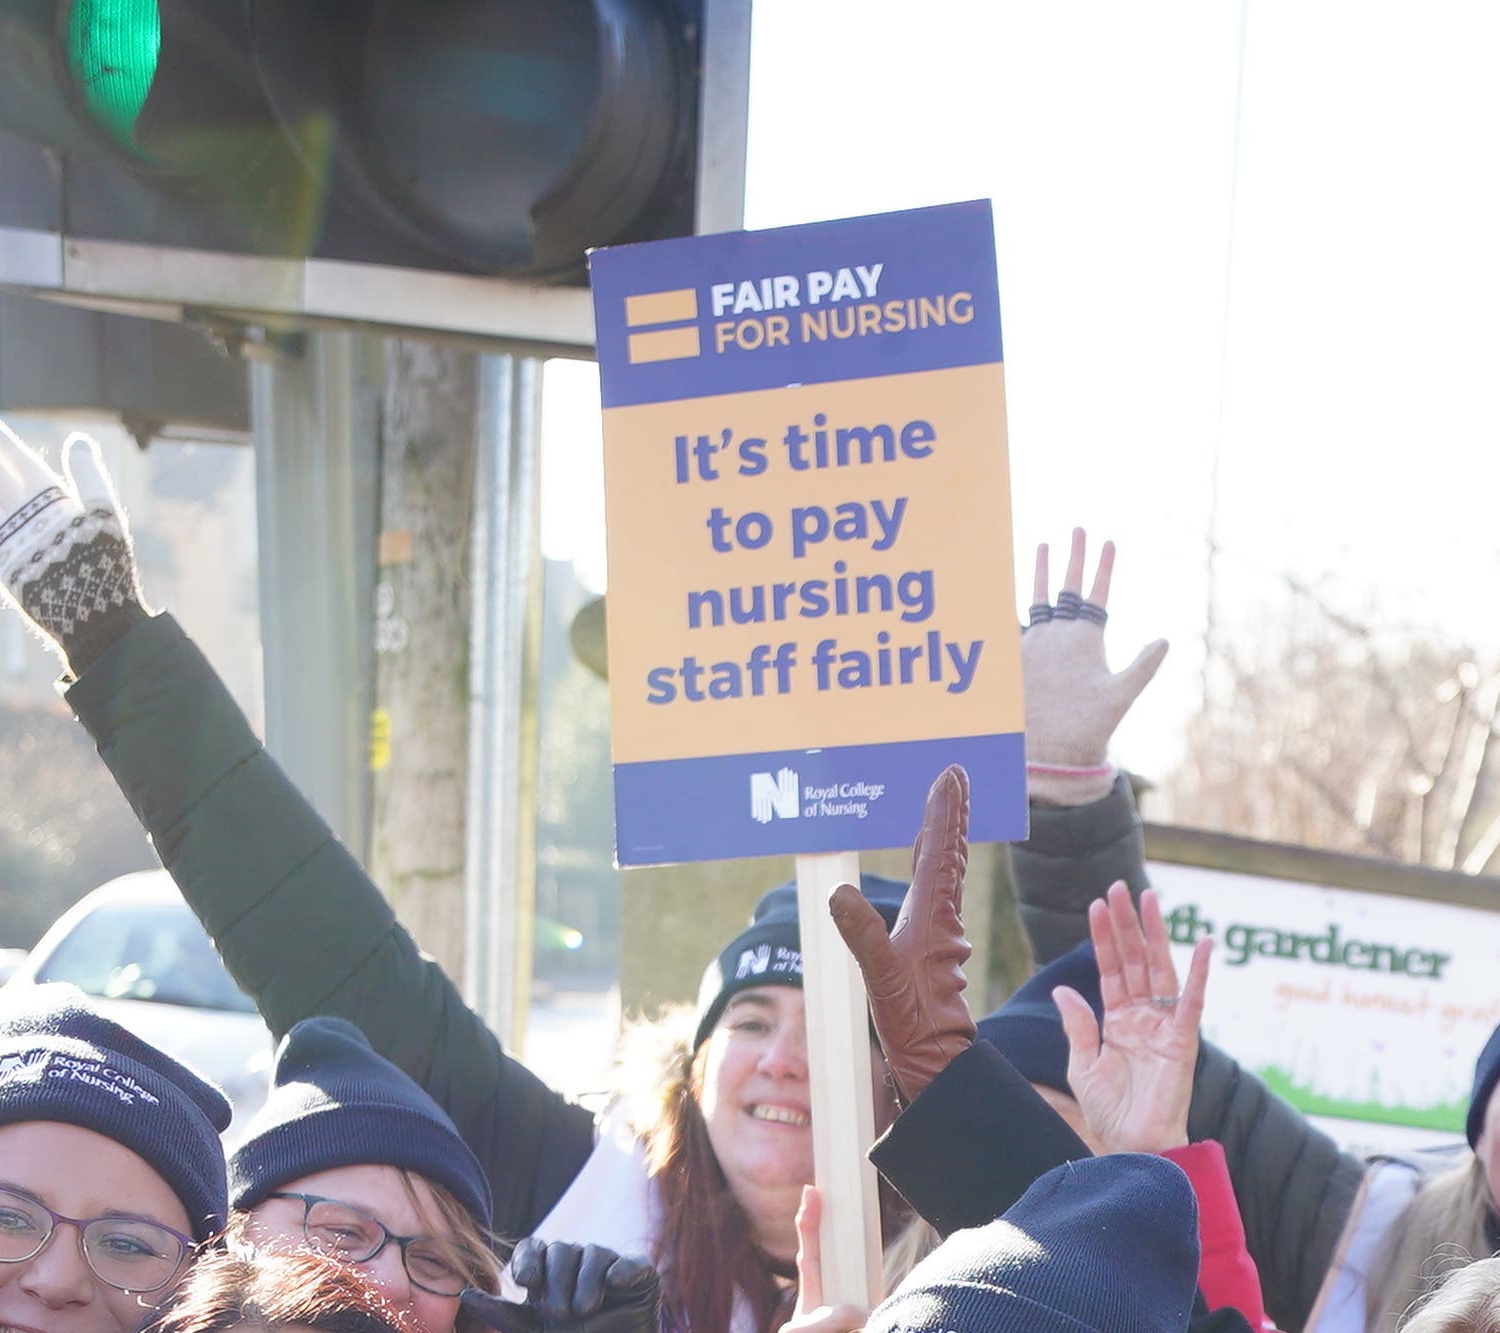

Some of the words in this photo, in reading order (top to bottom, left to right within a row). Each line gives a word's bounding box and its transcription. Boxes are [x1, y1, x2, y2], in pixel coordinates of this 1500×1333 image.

[711, 275, 799, 316] FAIR
[808, 264, 884, 301] PAY
[716, 319, 791, 354] FOR
[801, 292, 973, 342] NURSING
[675, 428, 768, 484] It's
[784, 414, 936, 467] time
[707, 505, 772, 553] to
[792, 496, 907, 557] pay
[687, 561, 935, 629] nursing
[646, 637, 796, 705] staff
[813, 630, 983, 692] fairly
[804, 784, 839, 802] Royal
[839, 782, 884, 800] College
[805, 804, 817, 817] of
[820, 802, 867, 818] Nursing
[1225, 924, 1452, 979] gardener
[48, 1068, 67, 1080] of
[69, 1069, 134, 1105] Nursing
[52, 1056, 100, 1076] Royal
[102, 1067, 160, 1106] College
